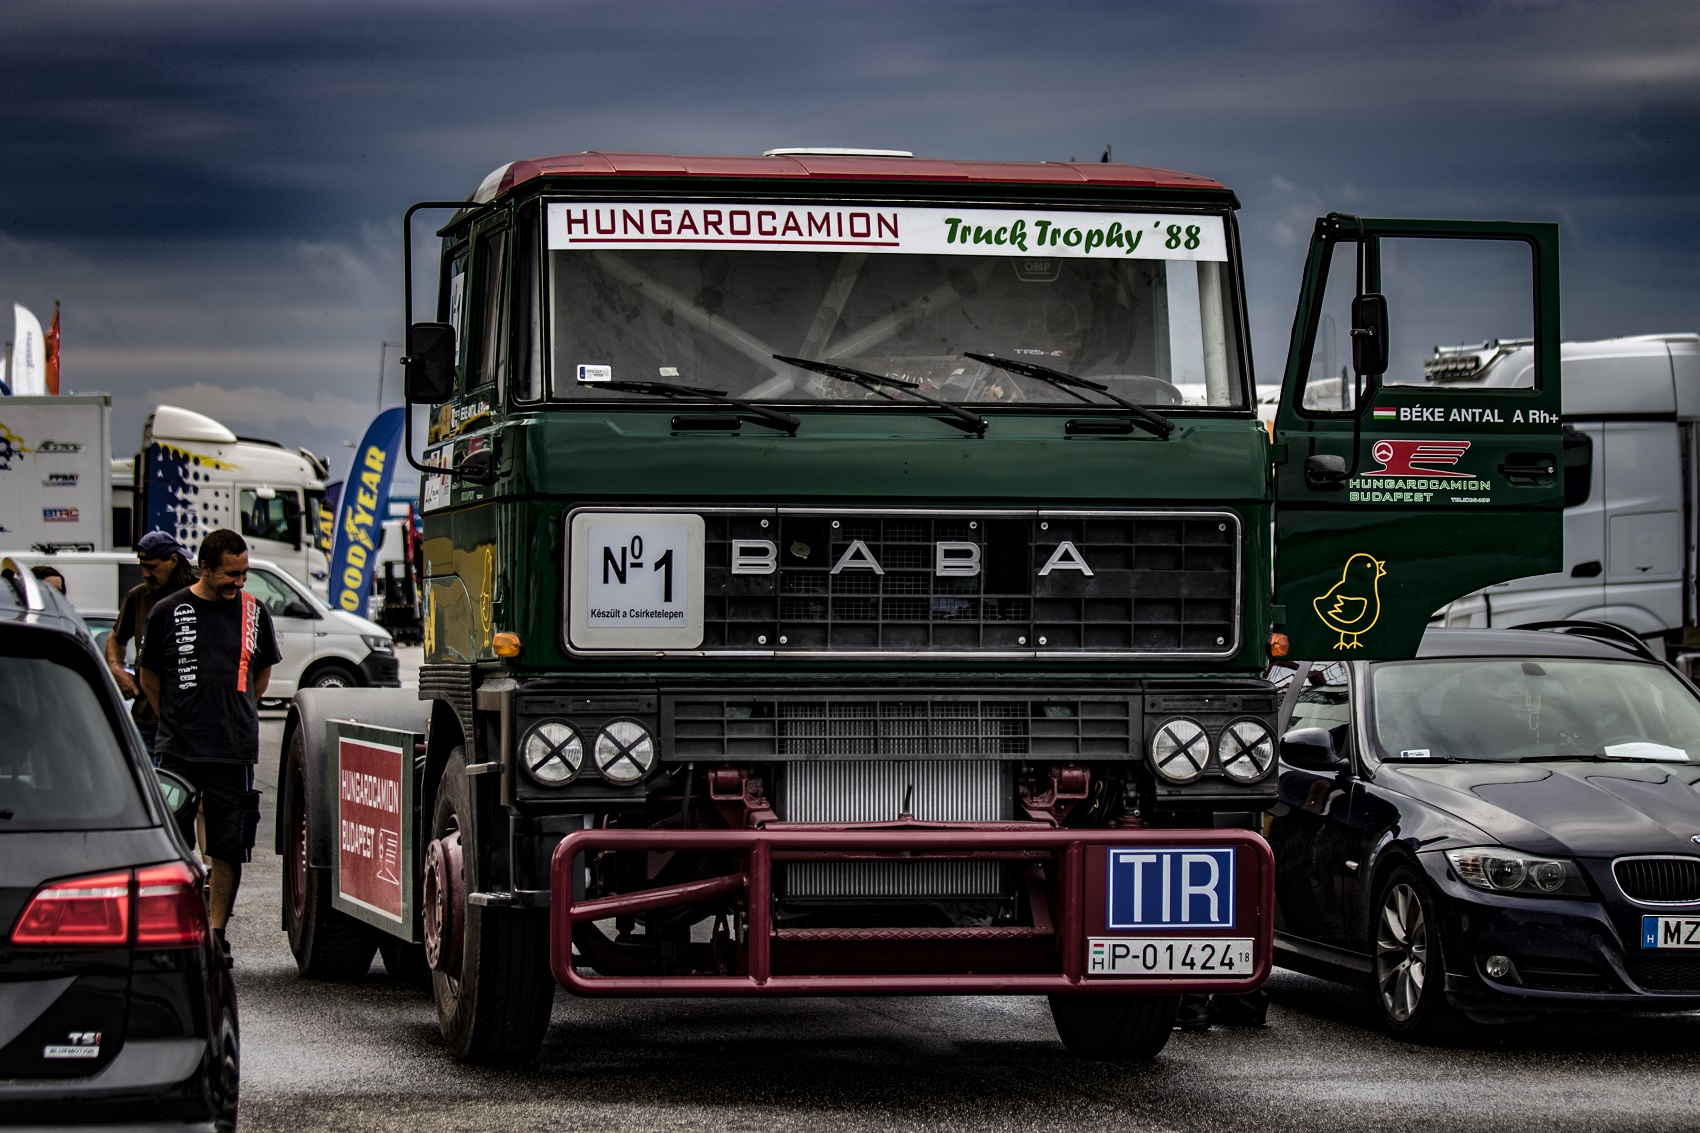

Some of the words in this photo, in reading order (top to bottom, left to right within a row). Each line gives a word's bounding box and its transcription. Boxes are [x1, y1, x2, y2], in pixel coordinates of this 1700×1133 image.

[566, 209, 899, 239] HUNGAROCAMION
[945, 218, 1027, 252] Truck
[1035, 221, 1143, 254] Trophy
[1024, 261, 1051, 274] OMP
[1400, 404, 1444, 422] BÉKE
[1449, 408, 1504, 423] ANTAL
[1512, 409, 1524, 424] A
[1529, 409, 1560, 424] Rh+
[1349, 479, 1491, 491] HUNGAROCAMION
[1349, 492, 1433, 504] BUDAPEST
[340, 445, 386, 612] OODYEAR
[731, 538, 1094, 576] BABA
[654, 549, 673, 602] 1
[590, 608, 620, 618] Készült
[629, 608, 684, 620] Csirketelepen
[342, 769, 398, 814] HUNGAROCAMION
[342, 819, 375, 859] BUDAPEST
[1119, 854, 1220, 922] TIR
[1647, 934, 1655, 943] H
[1093, 957, 1104, 970] H
[1112, 943, 1235, 970] P-01424
[1238, 952, 1250, 963] 18
